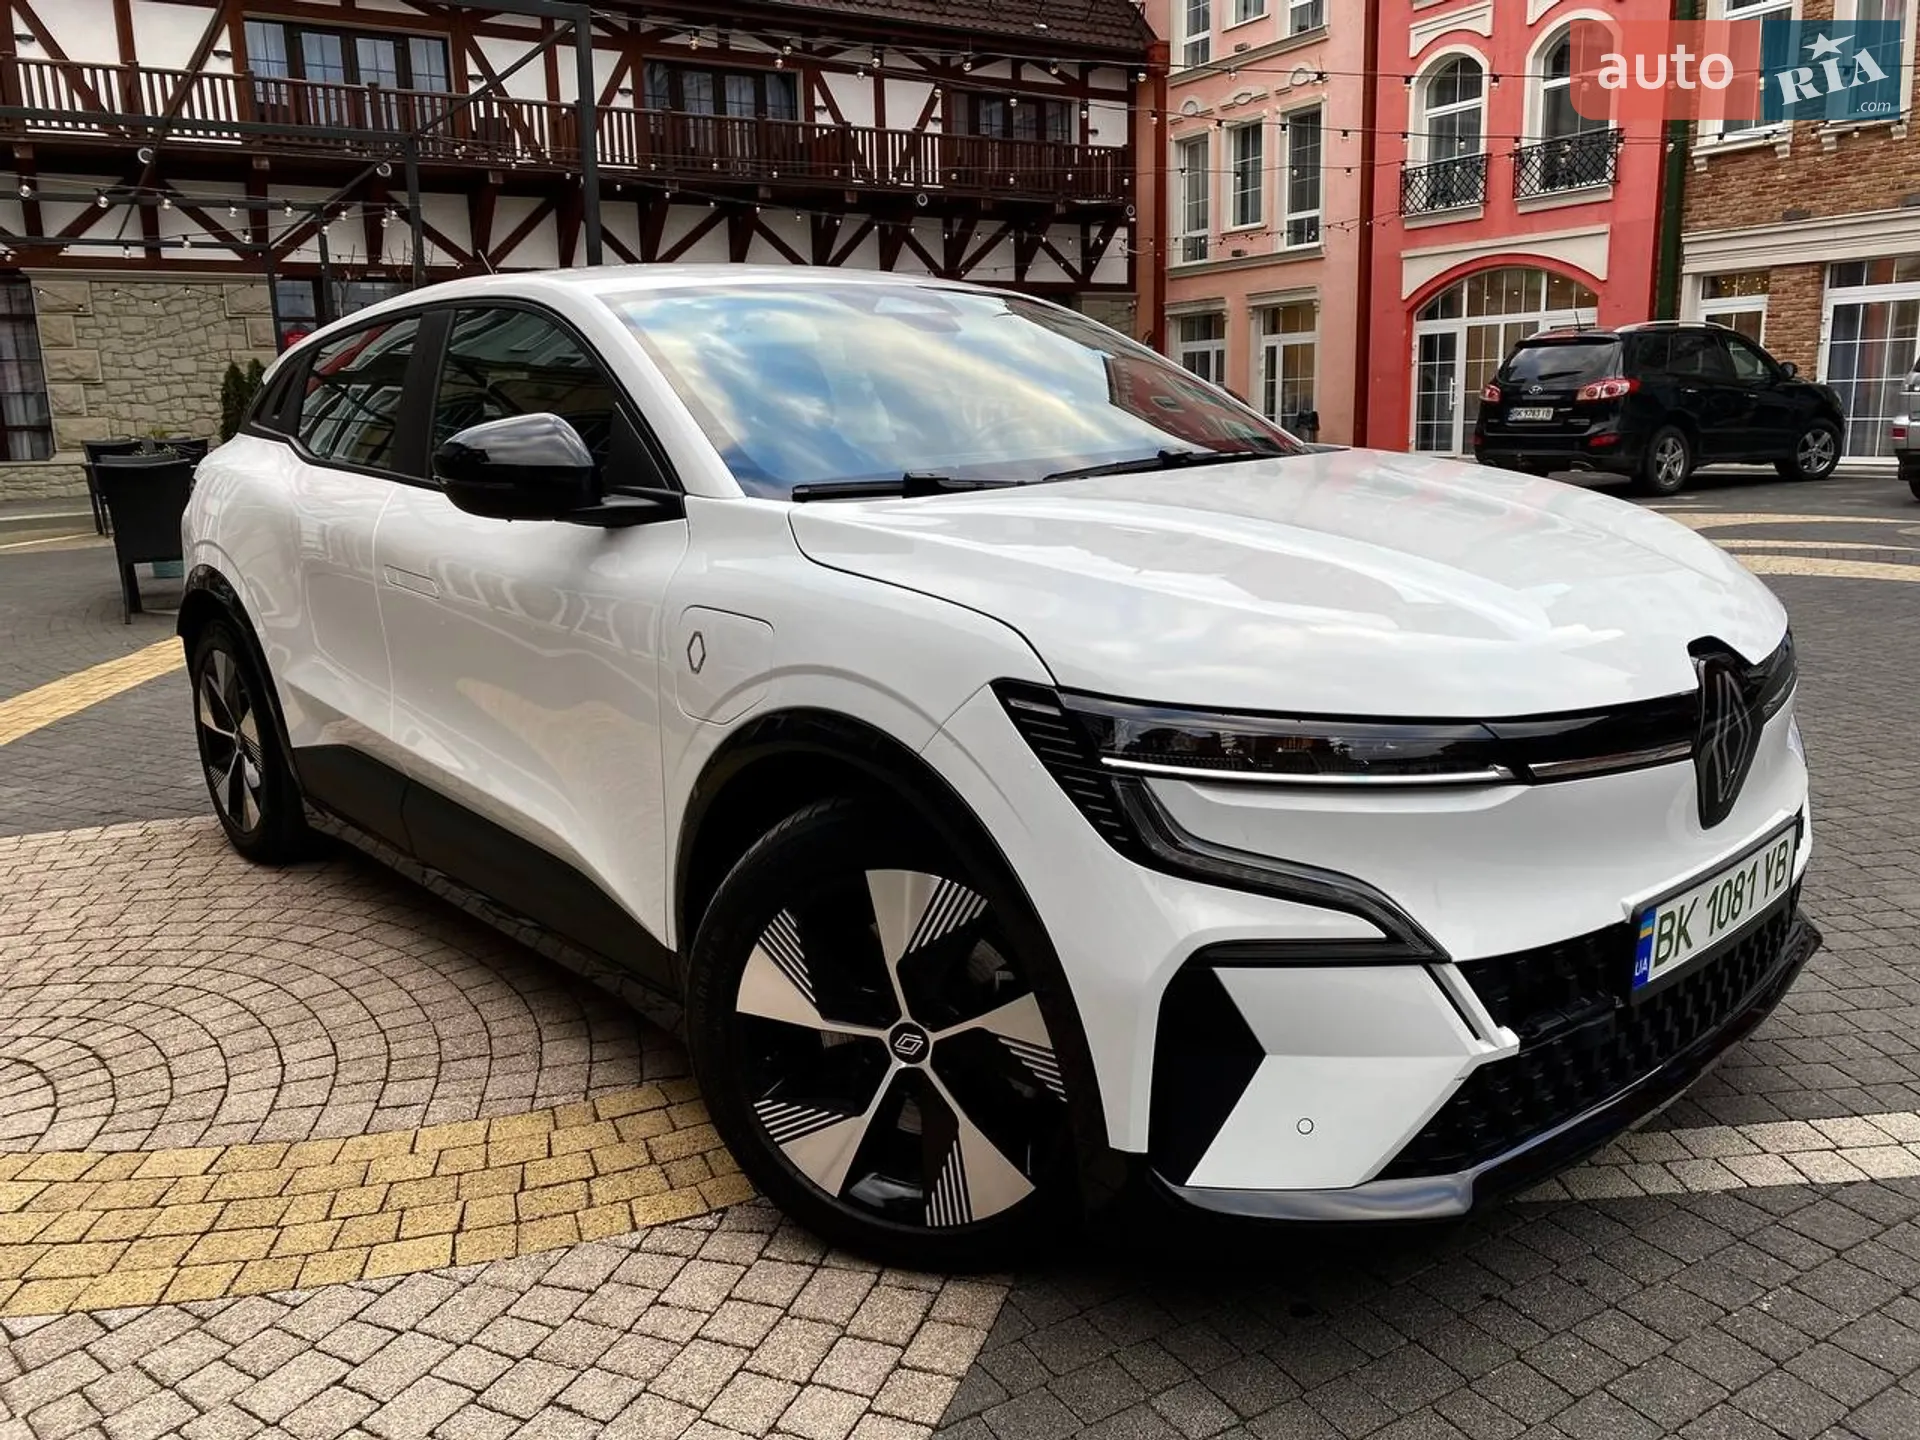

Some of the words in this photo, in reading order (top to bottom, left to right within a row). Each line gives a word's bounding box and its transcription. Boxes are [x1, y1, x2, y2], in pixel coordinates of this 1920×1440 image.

[1653, 896, 1699, 968] BK
[1706, 861, 1758, 937] 1081
[1764, 839, 1788, 899] YB
[1635, 957, 1648, 976] UA
